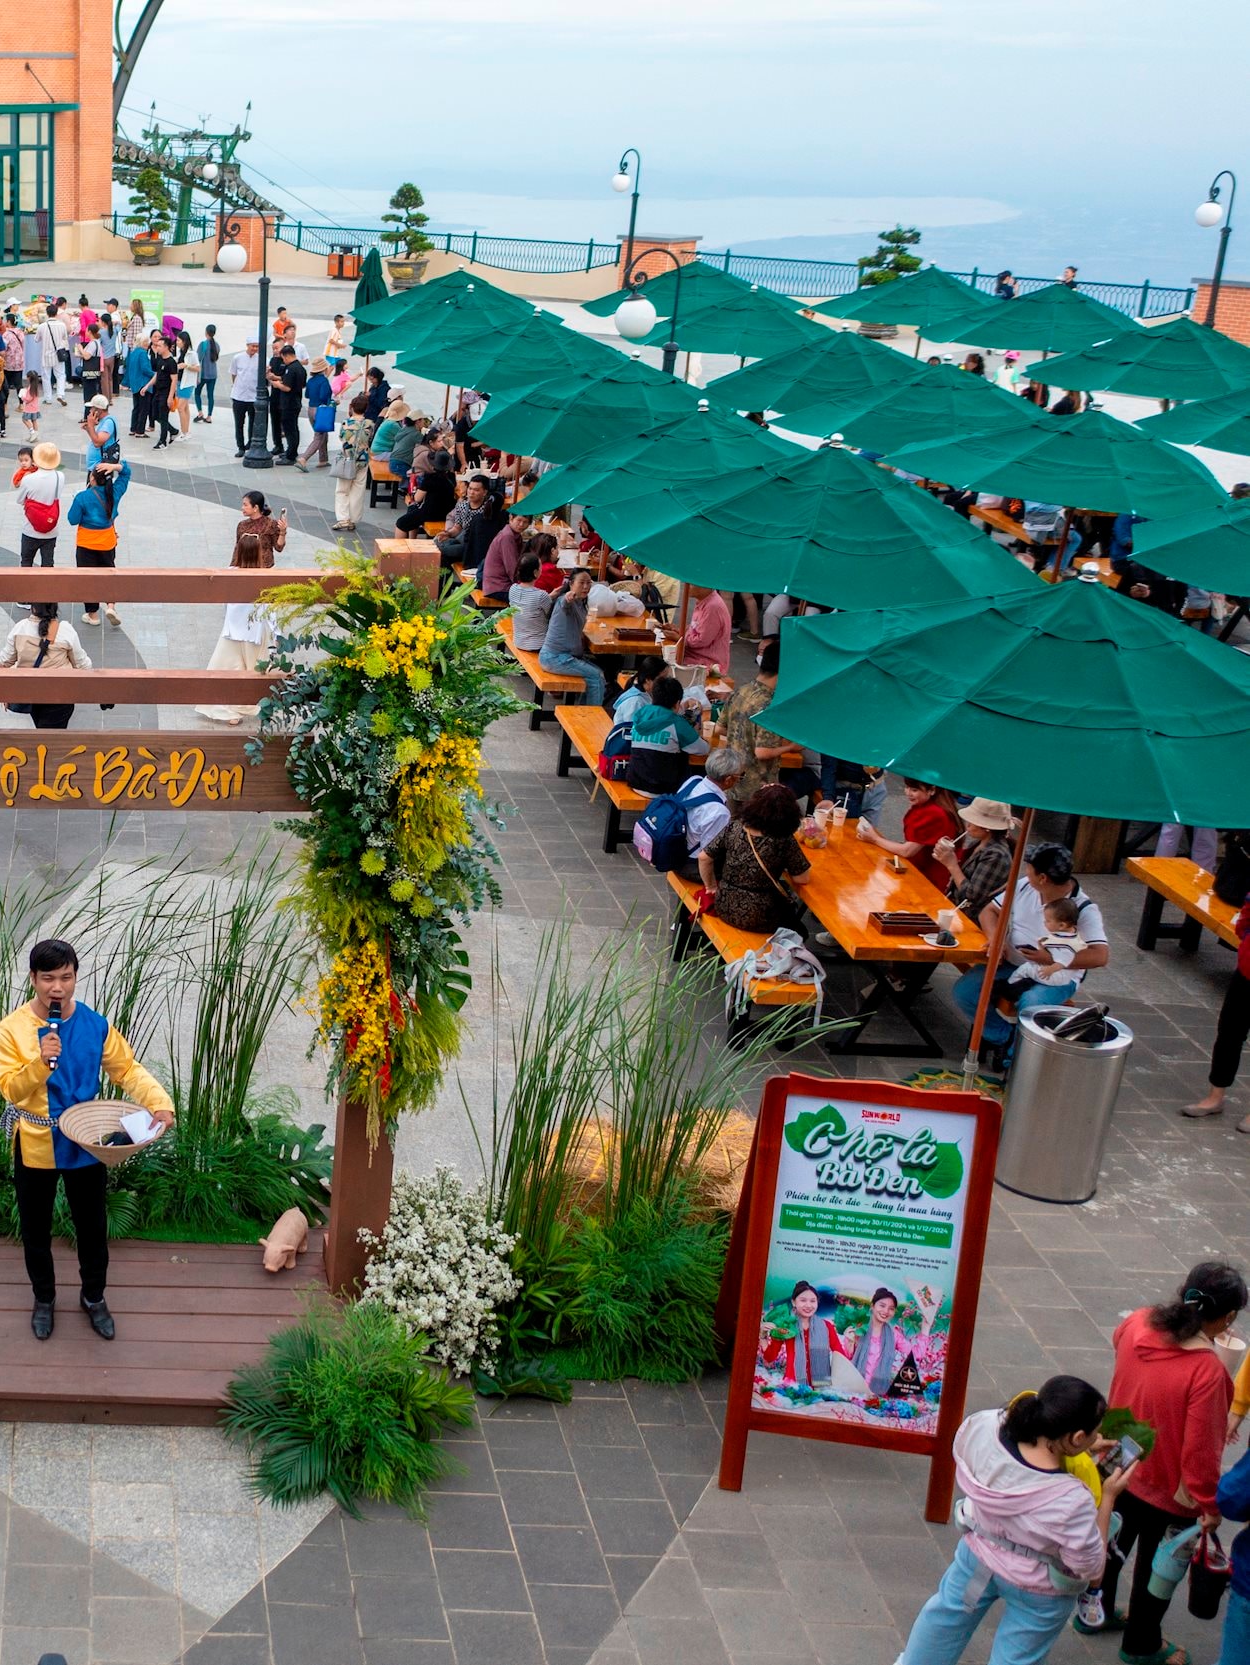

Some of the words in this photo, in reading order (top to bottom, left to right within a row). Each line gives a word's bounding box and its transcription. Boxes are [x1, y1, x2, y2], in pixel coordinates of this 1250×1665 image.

[28, 744, 87, 802] Lá
[93, 746, 159, 804] Bà
[158, 747, 244, 808] Đen
[803, 1121, 894, 1167] Chợ
[895, 1126, 939, 1168] lá
[817, 1160, 863, 1190] Bà
[865, 1166, 924, 1199] Đen
[785, 1190, 810, 1201] Phiên
[812, 1193, 827, 1204] chợ
[930, 1207, 953, 1221] hàng
